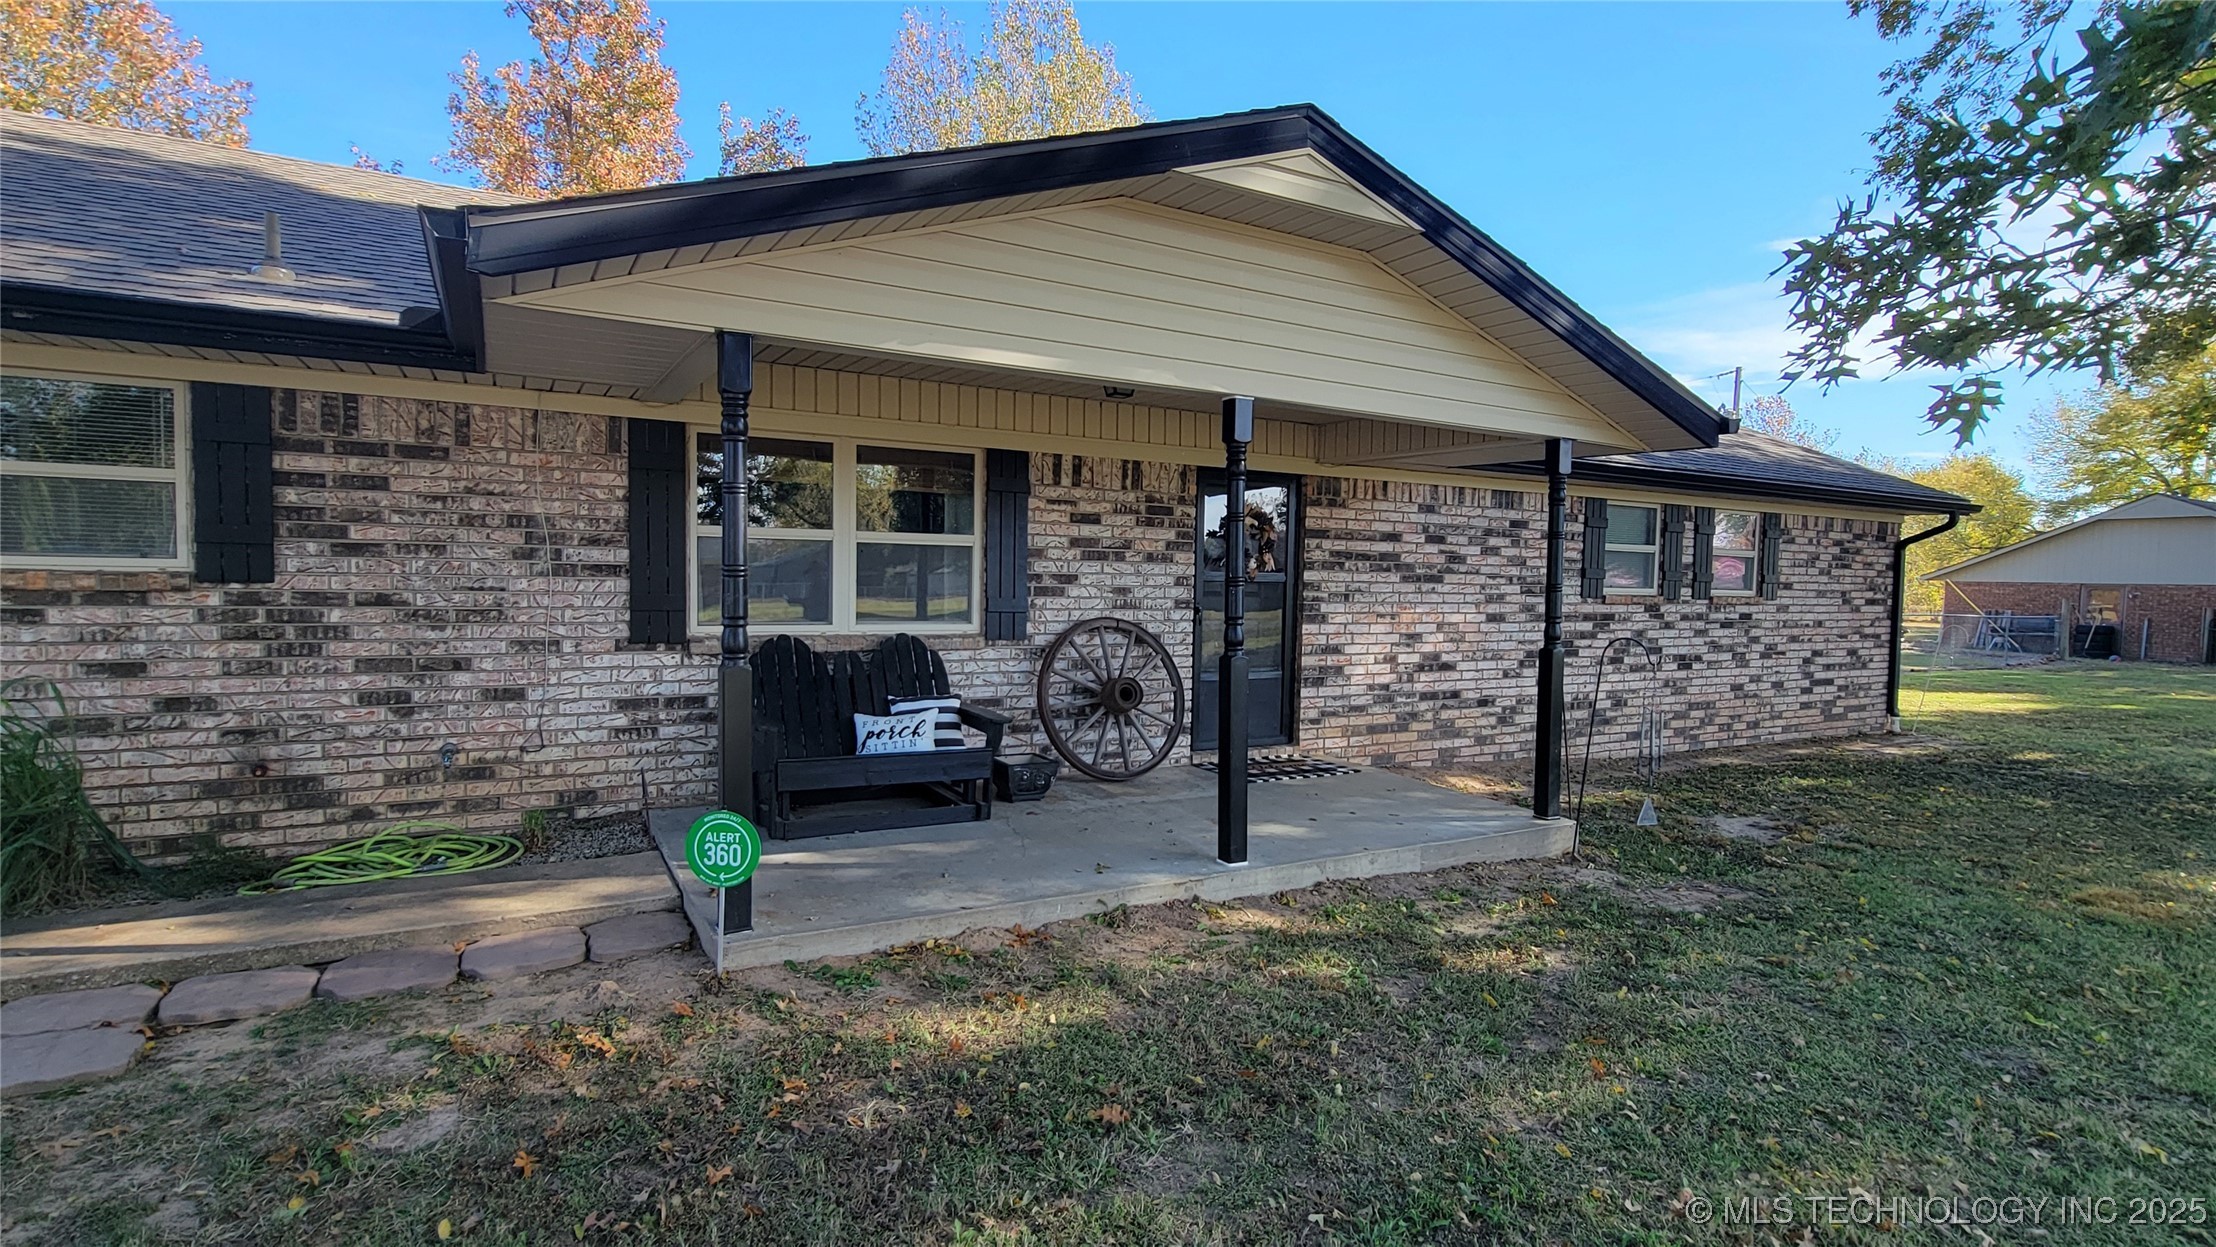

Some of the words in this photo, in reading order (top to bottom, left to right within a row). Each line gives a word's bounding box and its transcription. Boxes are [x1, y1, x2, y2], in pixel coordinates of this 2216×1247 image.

[862, 716, 916, 729] FRONT
[857, 719, 926, 754] porch
[729, 815, 742, 824] 24/7
[705, 832, 741, 843] ALERT
[703, 843, 742, 867] 360
